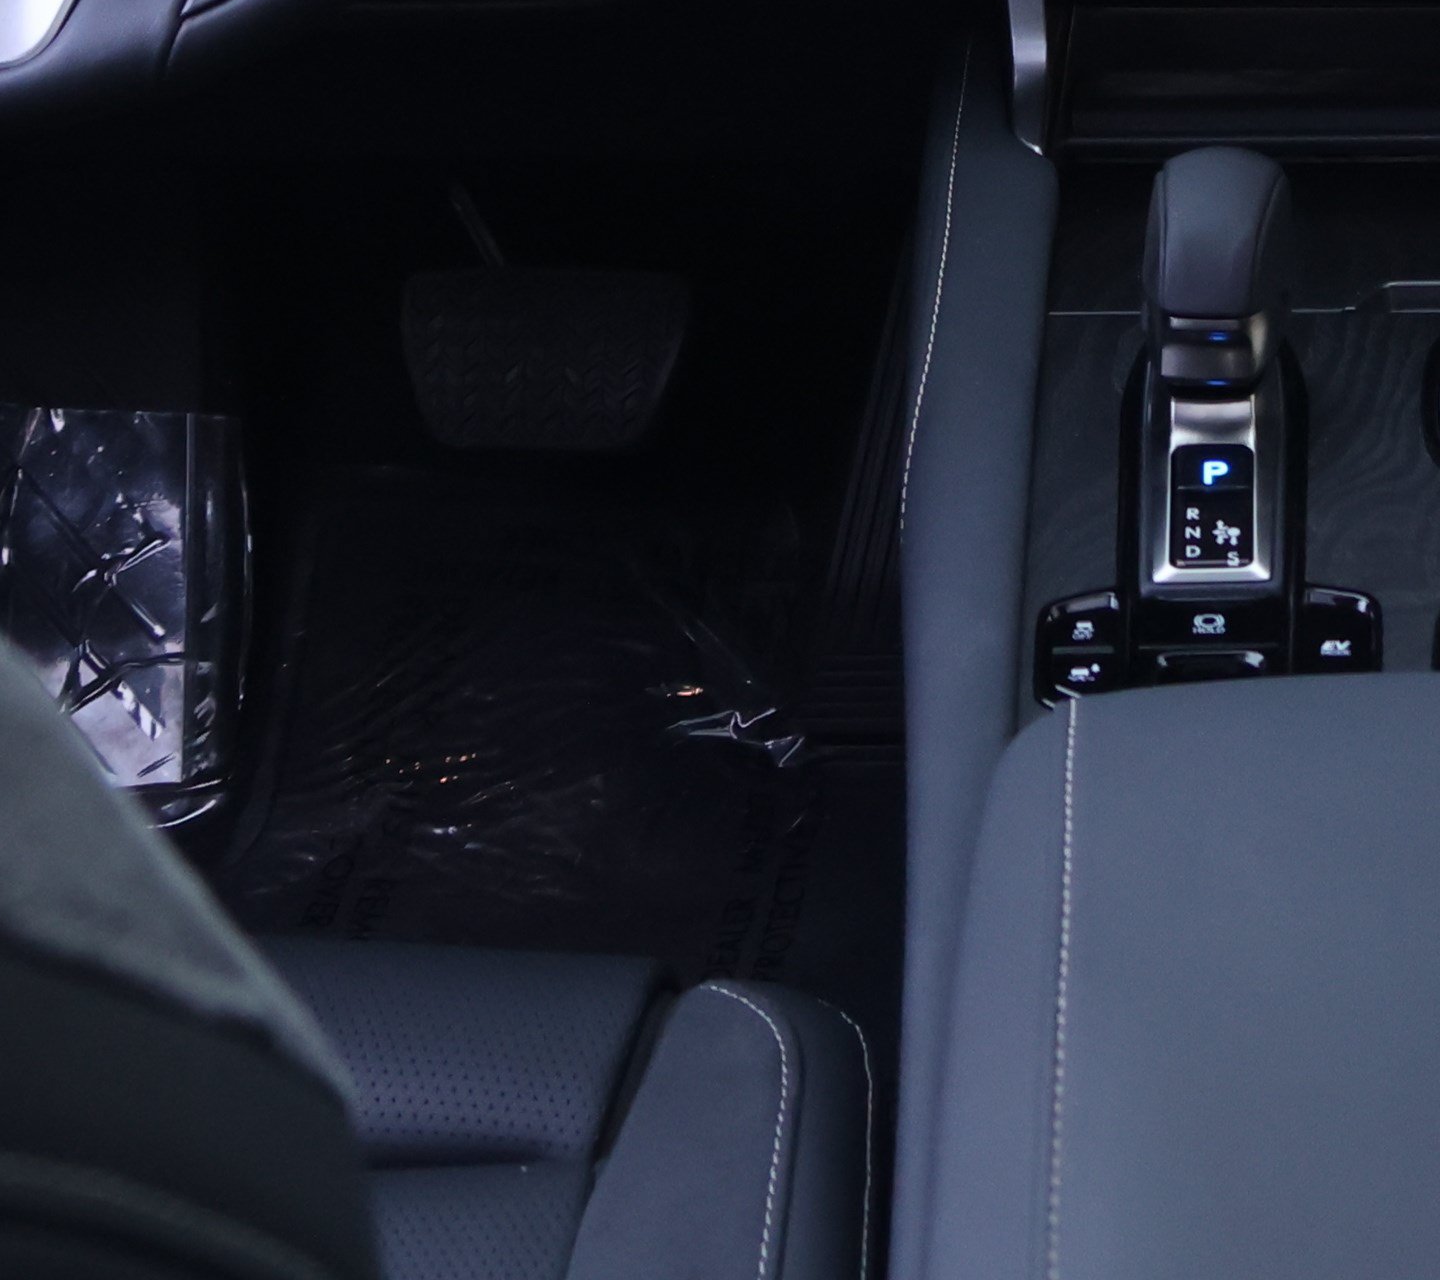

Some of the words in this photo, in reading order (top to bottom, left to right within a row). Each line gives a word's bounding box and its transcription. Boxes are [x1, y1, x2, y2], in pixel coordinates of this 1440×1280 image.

[1203, 460, 1229, 485] P
[1186, 507, 1200, 520] R
[1185, 526, 1201, 539] N
[1185, 544, 1201, 558] D
[1226, 551, 1240, 566] S
